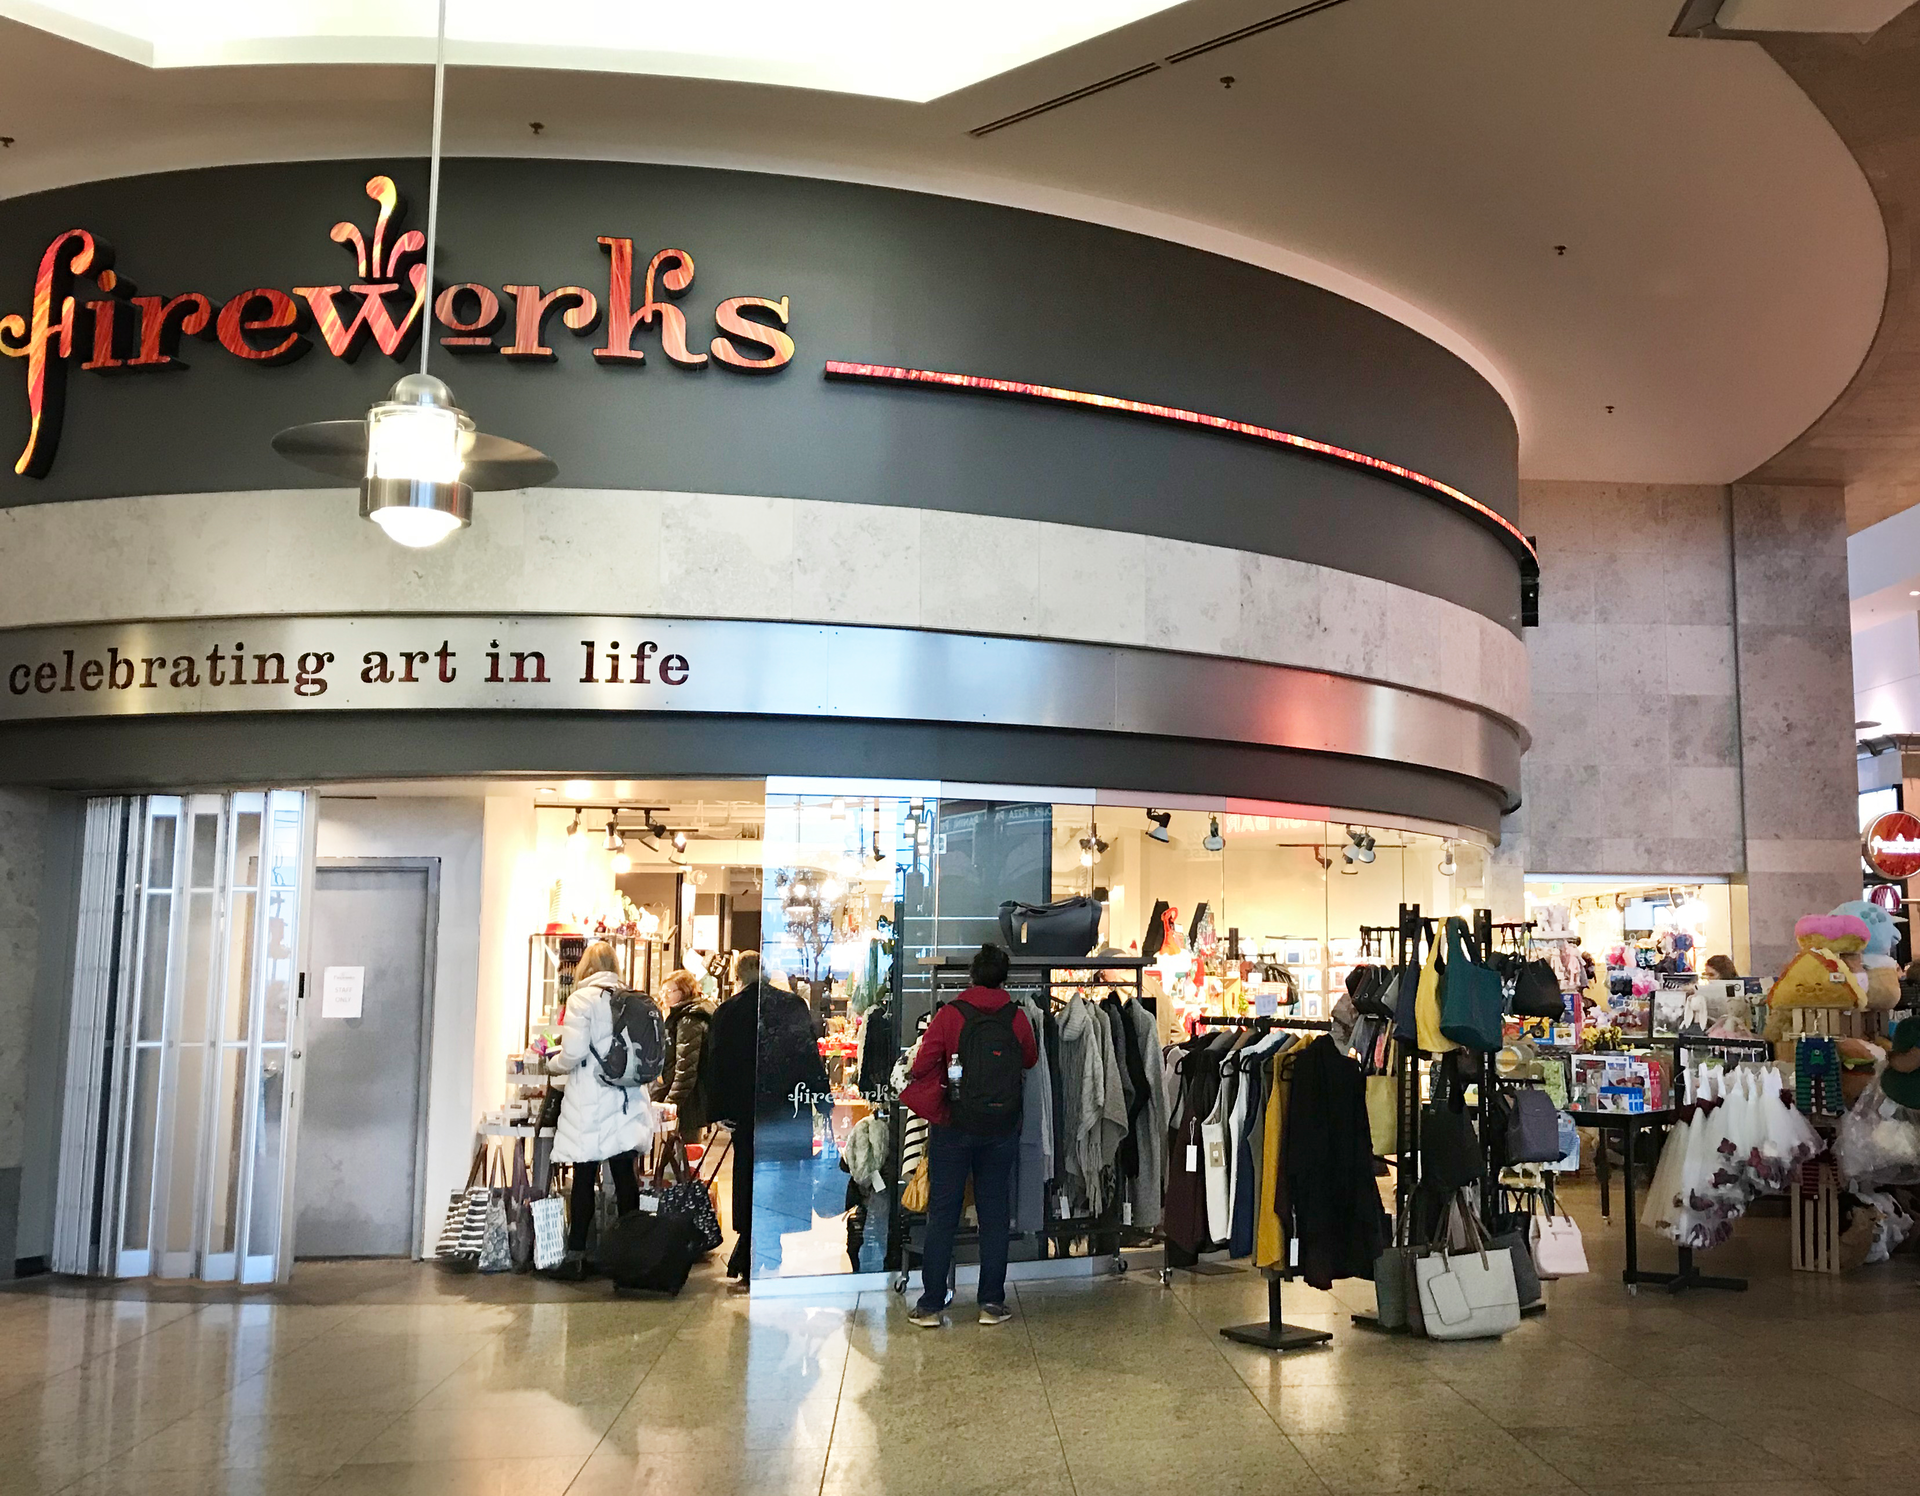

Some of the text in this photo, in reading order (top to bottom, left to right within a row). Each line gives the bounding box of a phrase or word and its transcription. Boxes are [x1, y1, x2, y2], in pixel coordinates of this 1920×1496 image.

[0, 176, 796, 478] fireworks
[8, 639, 690, 697] celebrating art in life
[787, 1081, 900, 1119] fireorks
